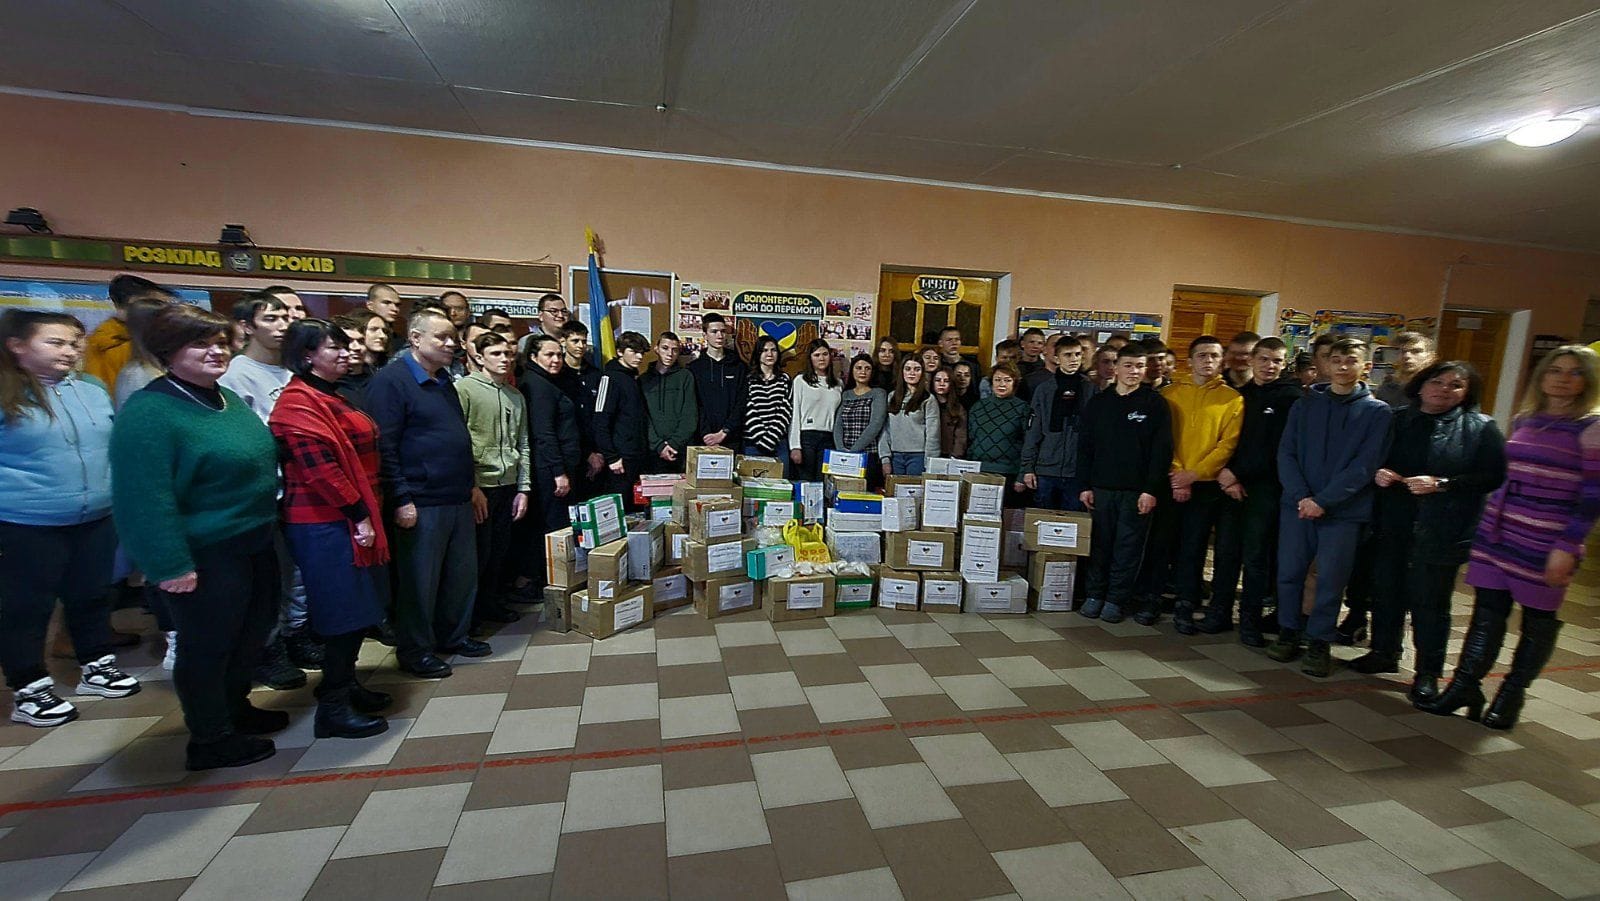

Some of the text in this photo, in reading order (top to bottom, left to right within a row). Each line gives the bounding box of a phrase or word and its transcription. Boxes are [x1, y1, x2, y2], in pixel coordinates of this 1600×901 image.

[123, 245, 335, 274] РОЗКЛАД УРОКІВ
[734, 302, 822, 315] КРОК ДО ПЕРЕМОГИ!
[1070, 319, 1081, 327] ДО
